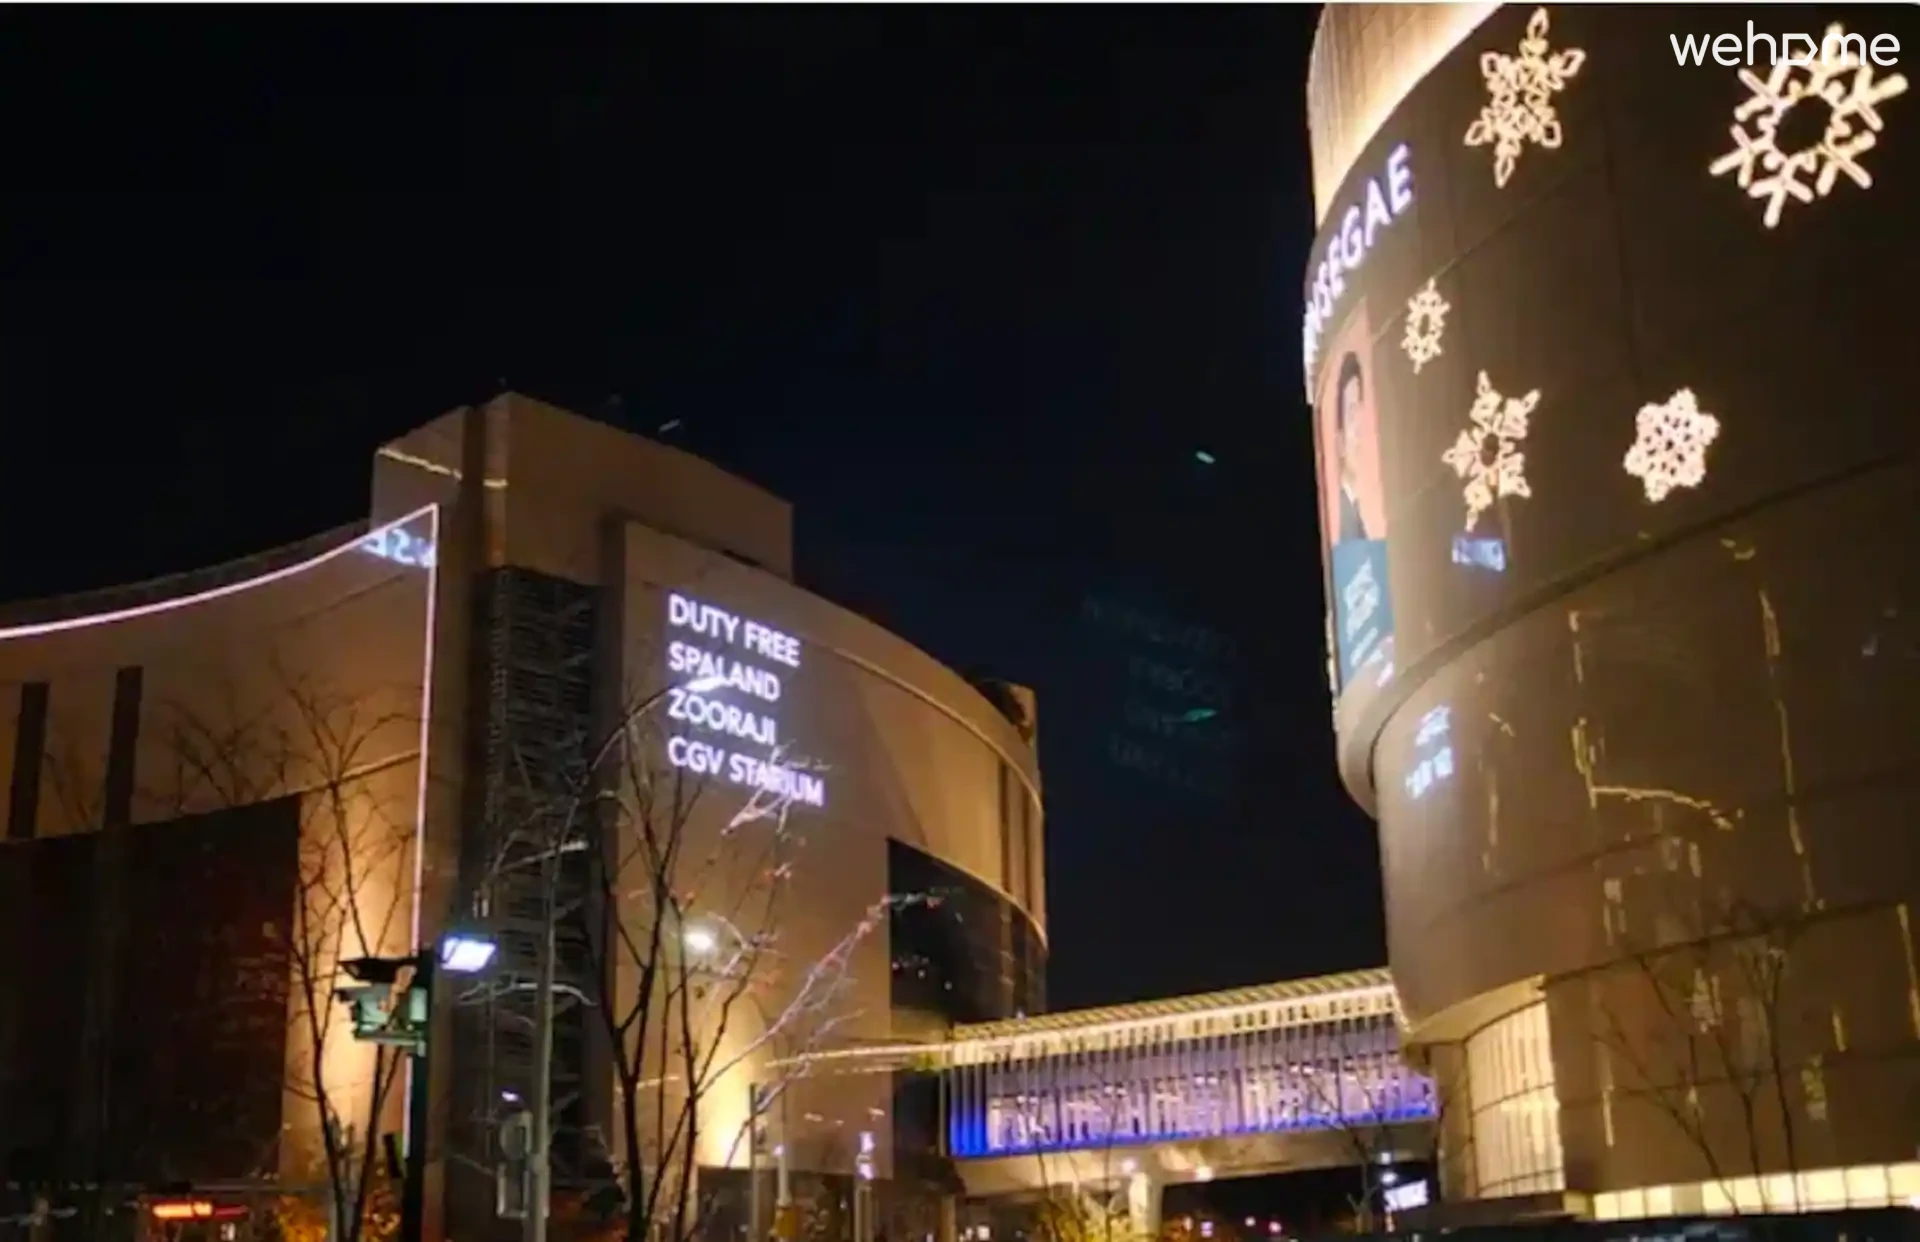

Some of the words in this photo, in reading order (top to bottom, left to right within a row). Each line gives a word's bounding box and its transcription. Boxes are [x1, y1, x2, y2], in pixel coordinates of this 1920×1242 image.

[668, 593, 739, 643] DUTY
[744, 621, 801, 667] FREE
[668, 641, 781, 702] SPALAND
[667, 688, 776, 746] ZOORAJI
[667, 736, 725, 775] CGV
